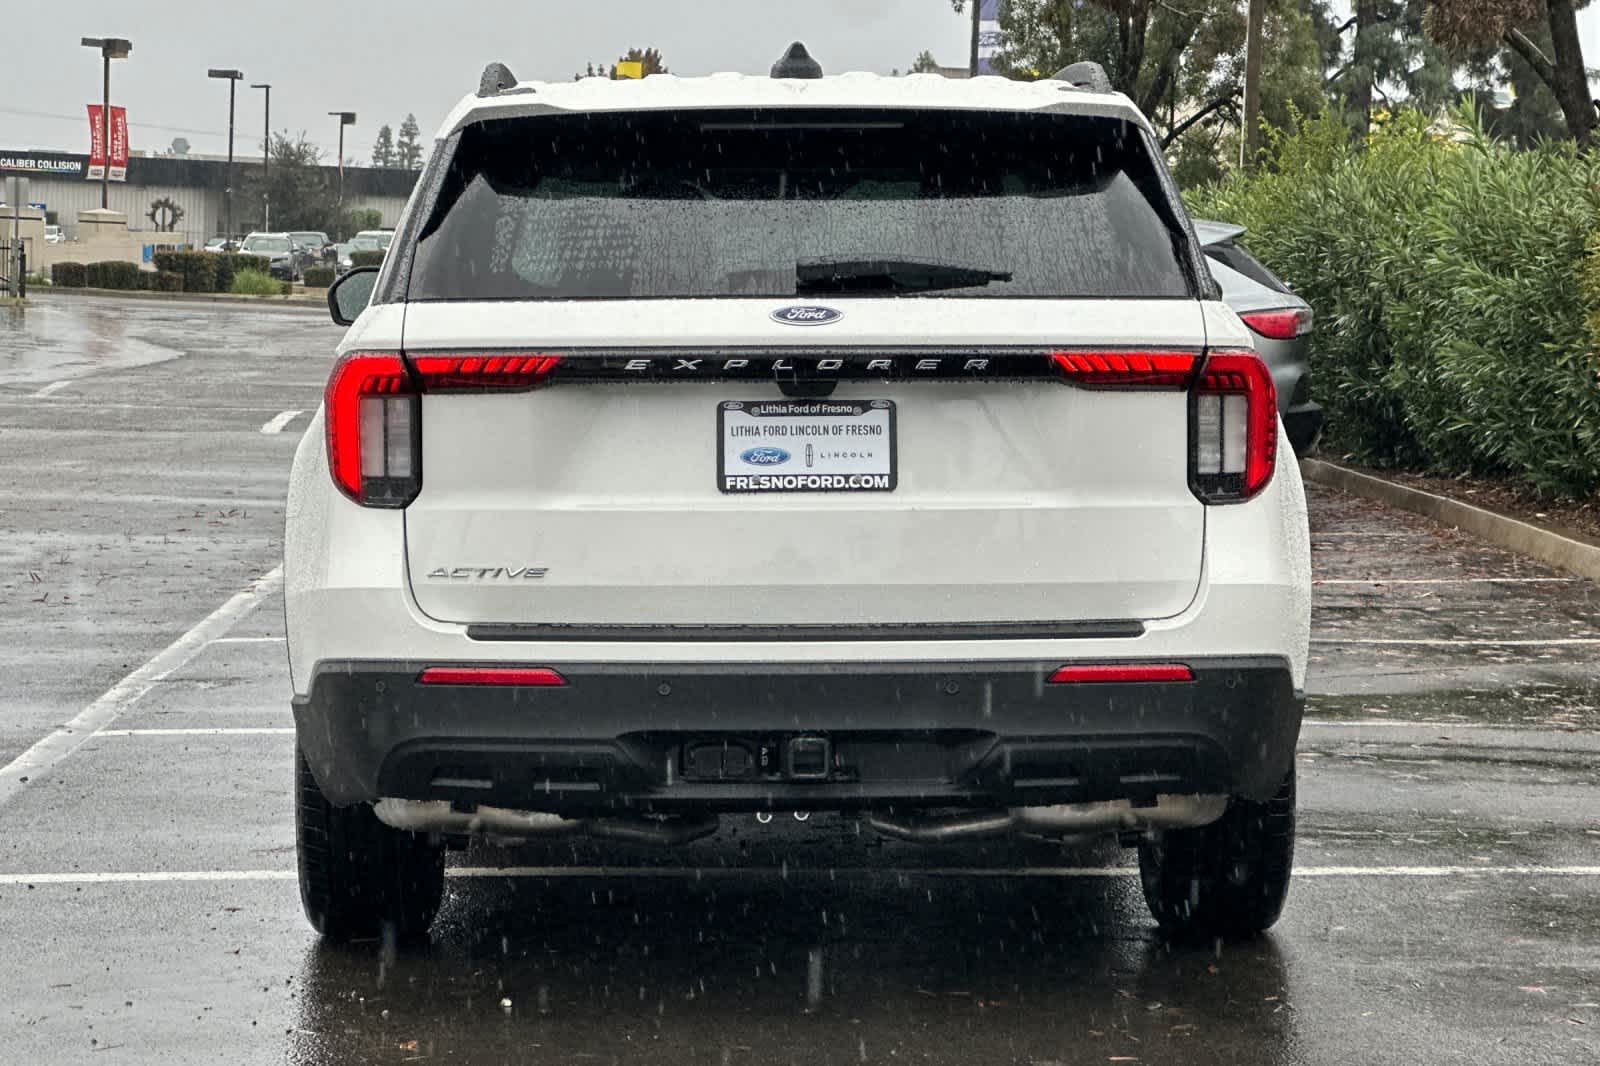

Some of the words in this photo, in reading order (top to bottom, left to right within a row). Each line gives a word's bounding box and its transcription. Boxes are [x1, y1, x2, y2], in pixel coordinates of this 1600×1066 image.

[0, 158, 36, 169] CALIBER
[37, 159, 81, 171] COLLISION
[624, 359, 990, 371] EXPLORER
[760, 405, 787, 414] Lithia
[788, 404, 809, 414] Ford
[810, 404, 820, 413] of
[822, 404, 853, 413] Fresno
[730, 425, 761, 437] LITHIA
[763, 425, 788, 437] FORD
[790, 425, 829, 436] LINCOLN
[831, 425, 844, 436] OF
[846, 424, 882, 436] FRESNO
[427, 567, 549, 578] ACTIVE
